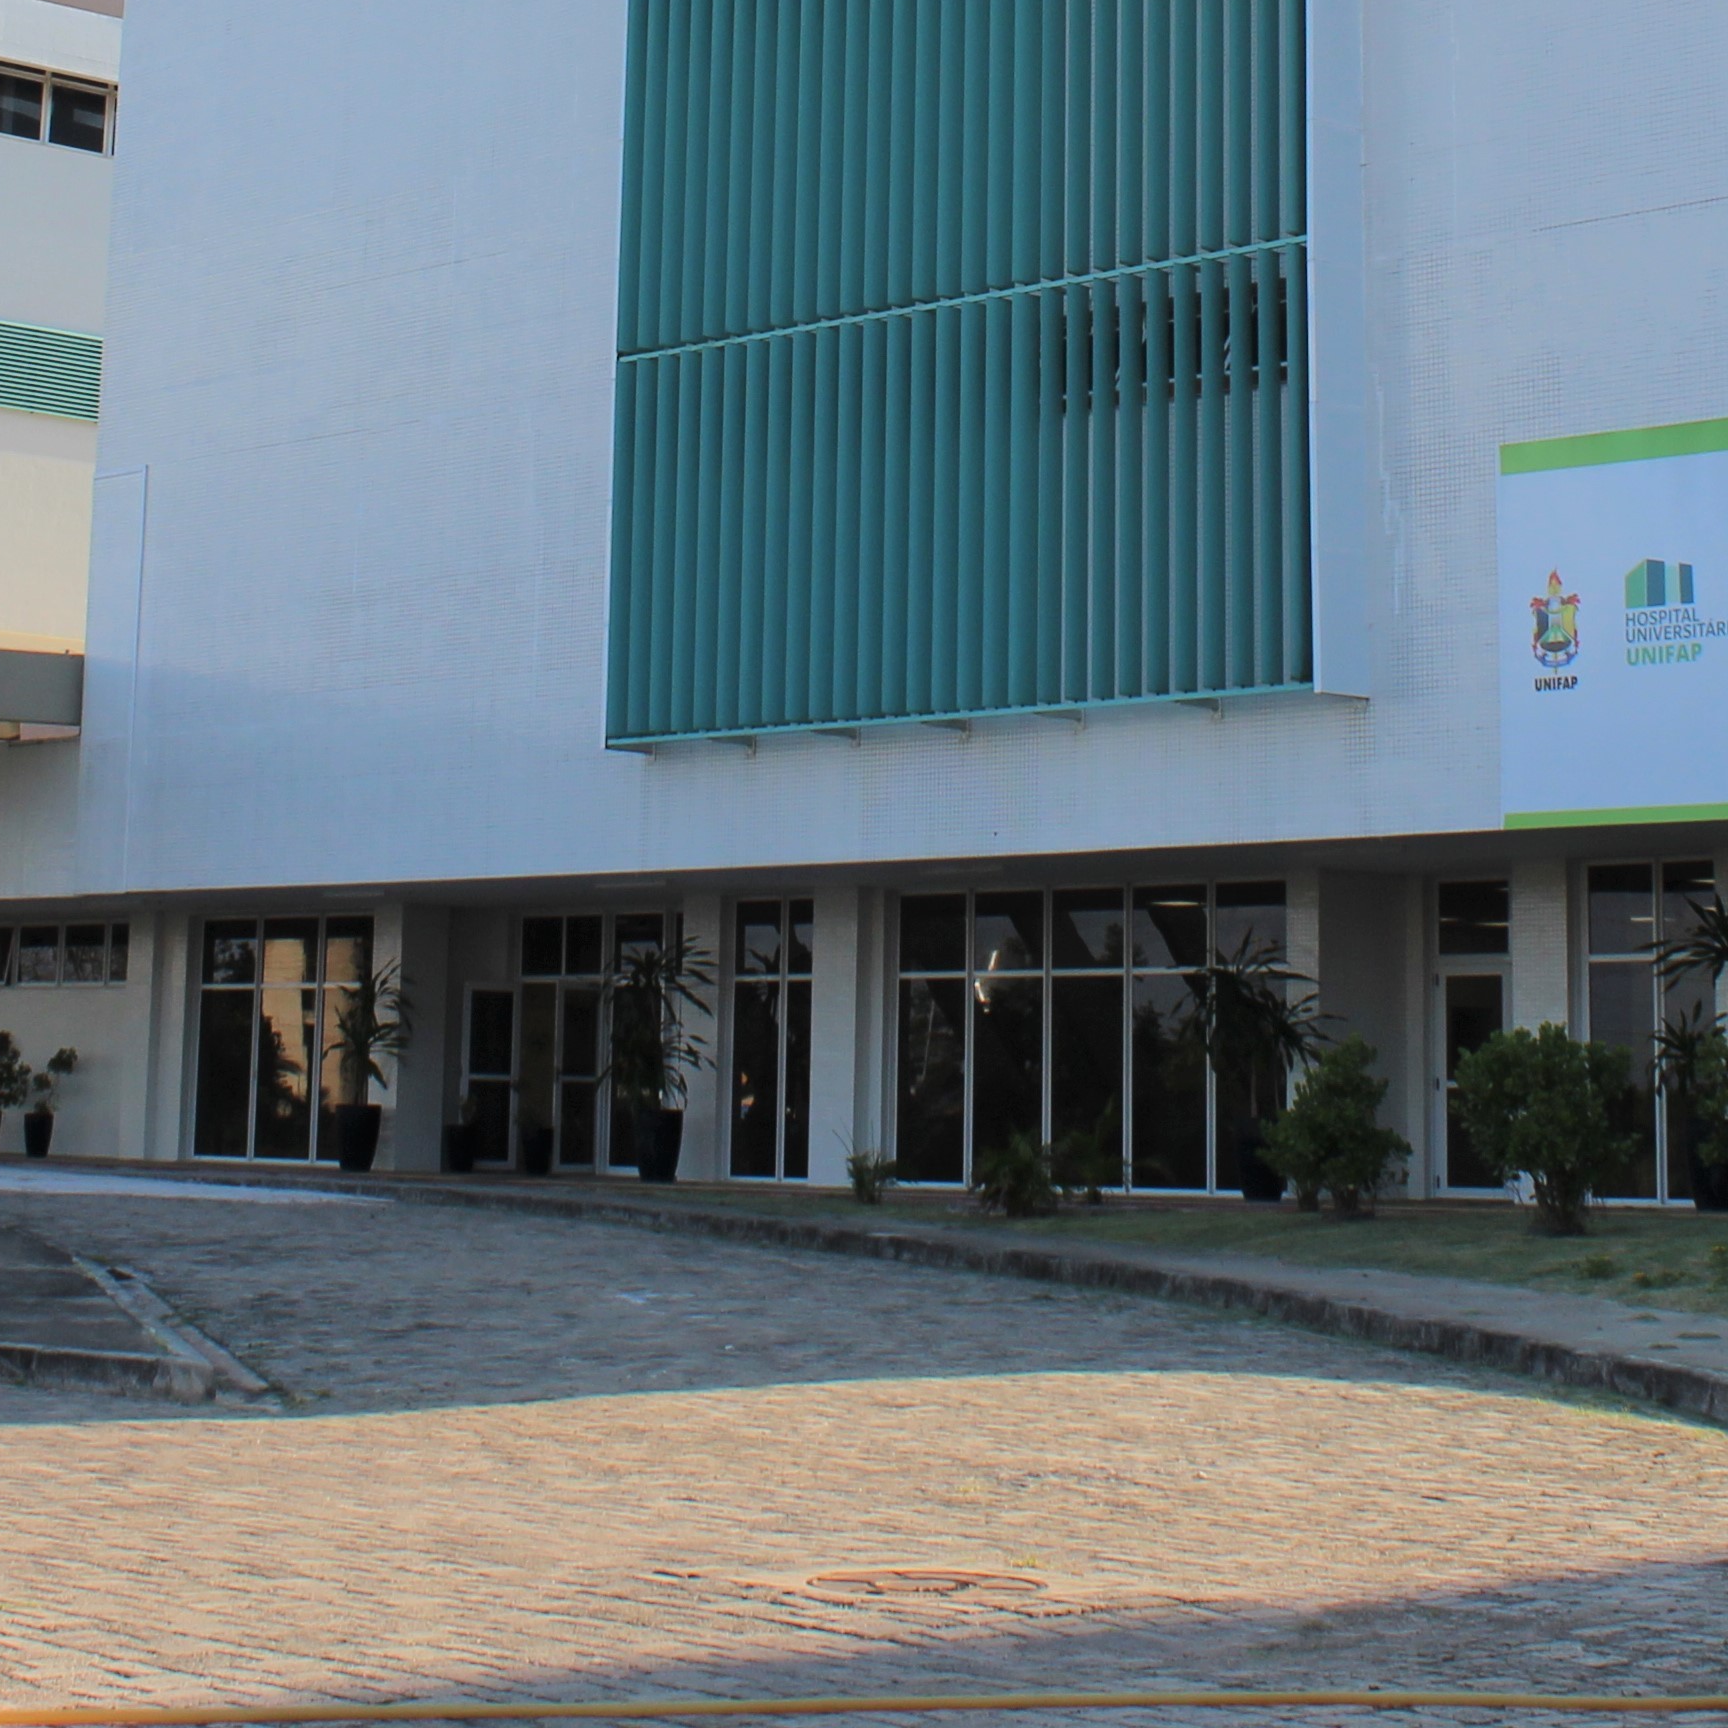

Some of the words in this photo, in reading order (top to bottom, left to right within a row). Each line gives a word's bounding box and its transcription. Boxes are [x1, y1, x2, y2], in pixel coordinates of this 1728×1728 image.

[1625, 607, 1700, 628] HOSPITAL
[1626, 642, 1703, 667] UNIFAP
[1534, 675, 1579, 693] UNIFAP
